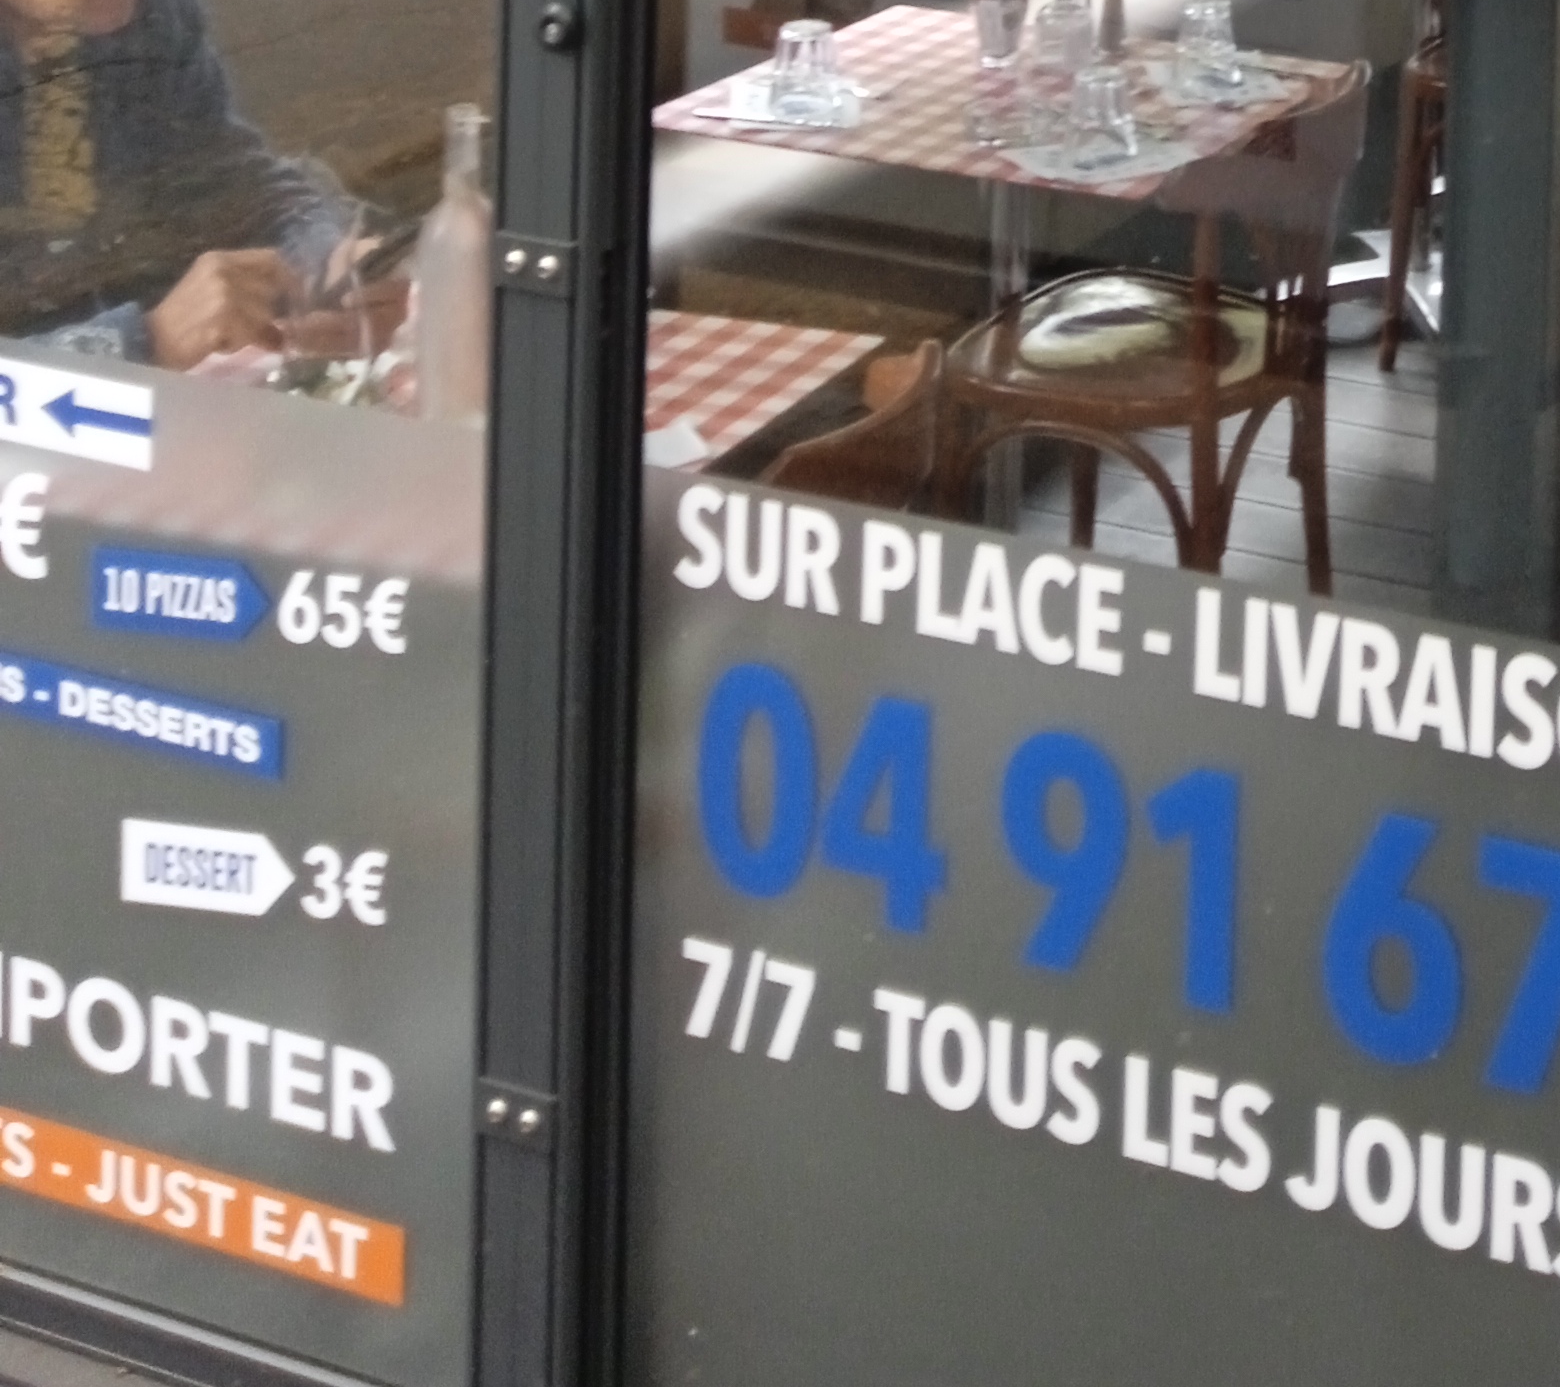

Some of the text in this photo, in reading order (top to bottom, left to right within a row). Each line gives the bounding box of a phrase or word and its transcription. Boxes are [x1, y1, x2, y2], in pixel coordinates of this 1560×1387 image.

[102, 566, 411, 655] 10 PIZZAS 65€
[673, 482, 842, 617] SUR
[859, 518, 1126, 677] PLACE
[58, 679, 262, 764] DESSERTS
[143, 840, 390, 927] DESSERT 3€
[699, 663, 948, 933] 04
[1001, 731, 1239, 1012] 91
[0, 949, 396, 1153] PORTER
[682, 936, 818, 1063] 7/7
[873, 985, 1102, 1146] TOUS
[1121, 1053, 1274, 1194] LES
[86, 1149, 237, 1239] JUST
[251, 1194, 369, 1280] EAT
